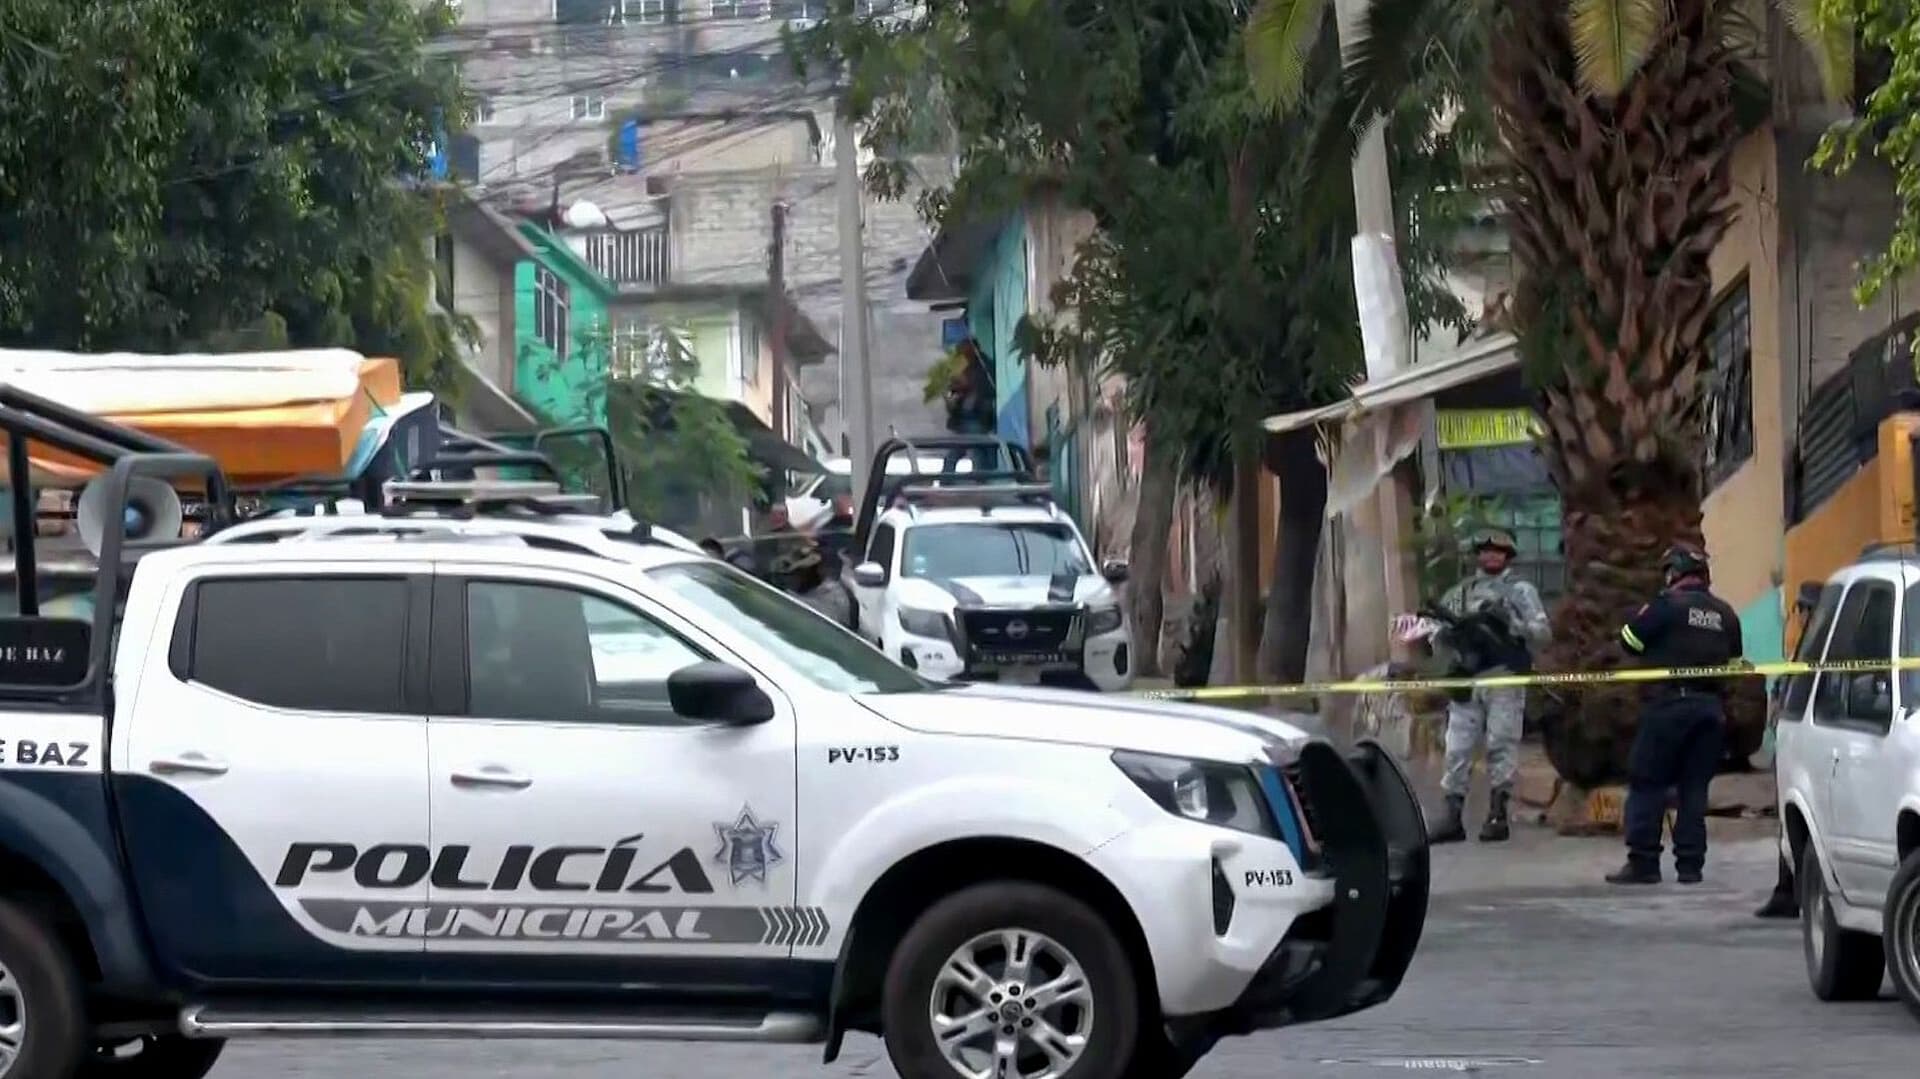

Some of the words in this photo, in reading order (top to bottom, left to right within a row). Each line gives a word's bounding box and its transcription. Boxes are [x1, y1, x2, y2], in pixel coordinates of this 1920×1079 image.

[16, 739, 89, 767] BAZ
[828, 747, 900, 763] PV-153
[275, 833, 715, 894] POLICÍA
[1245, 868, 1293, 887] PV-153
[350, 905, 713, 940] MUNICIPAL
